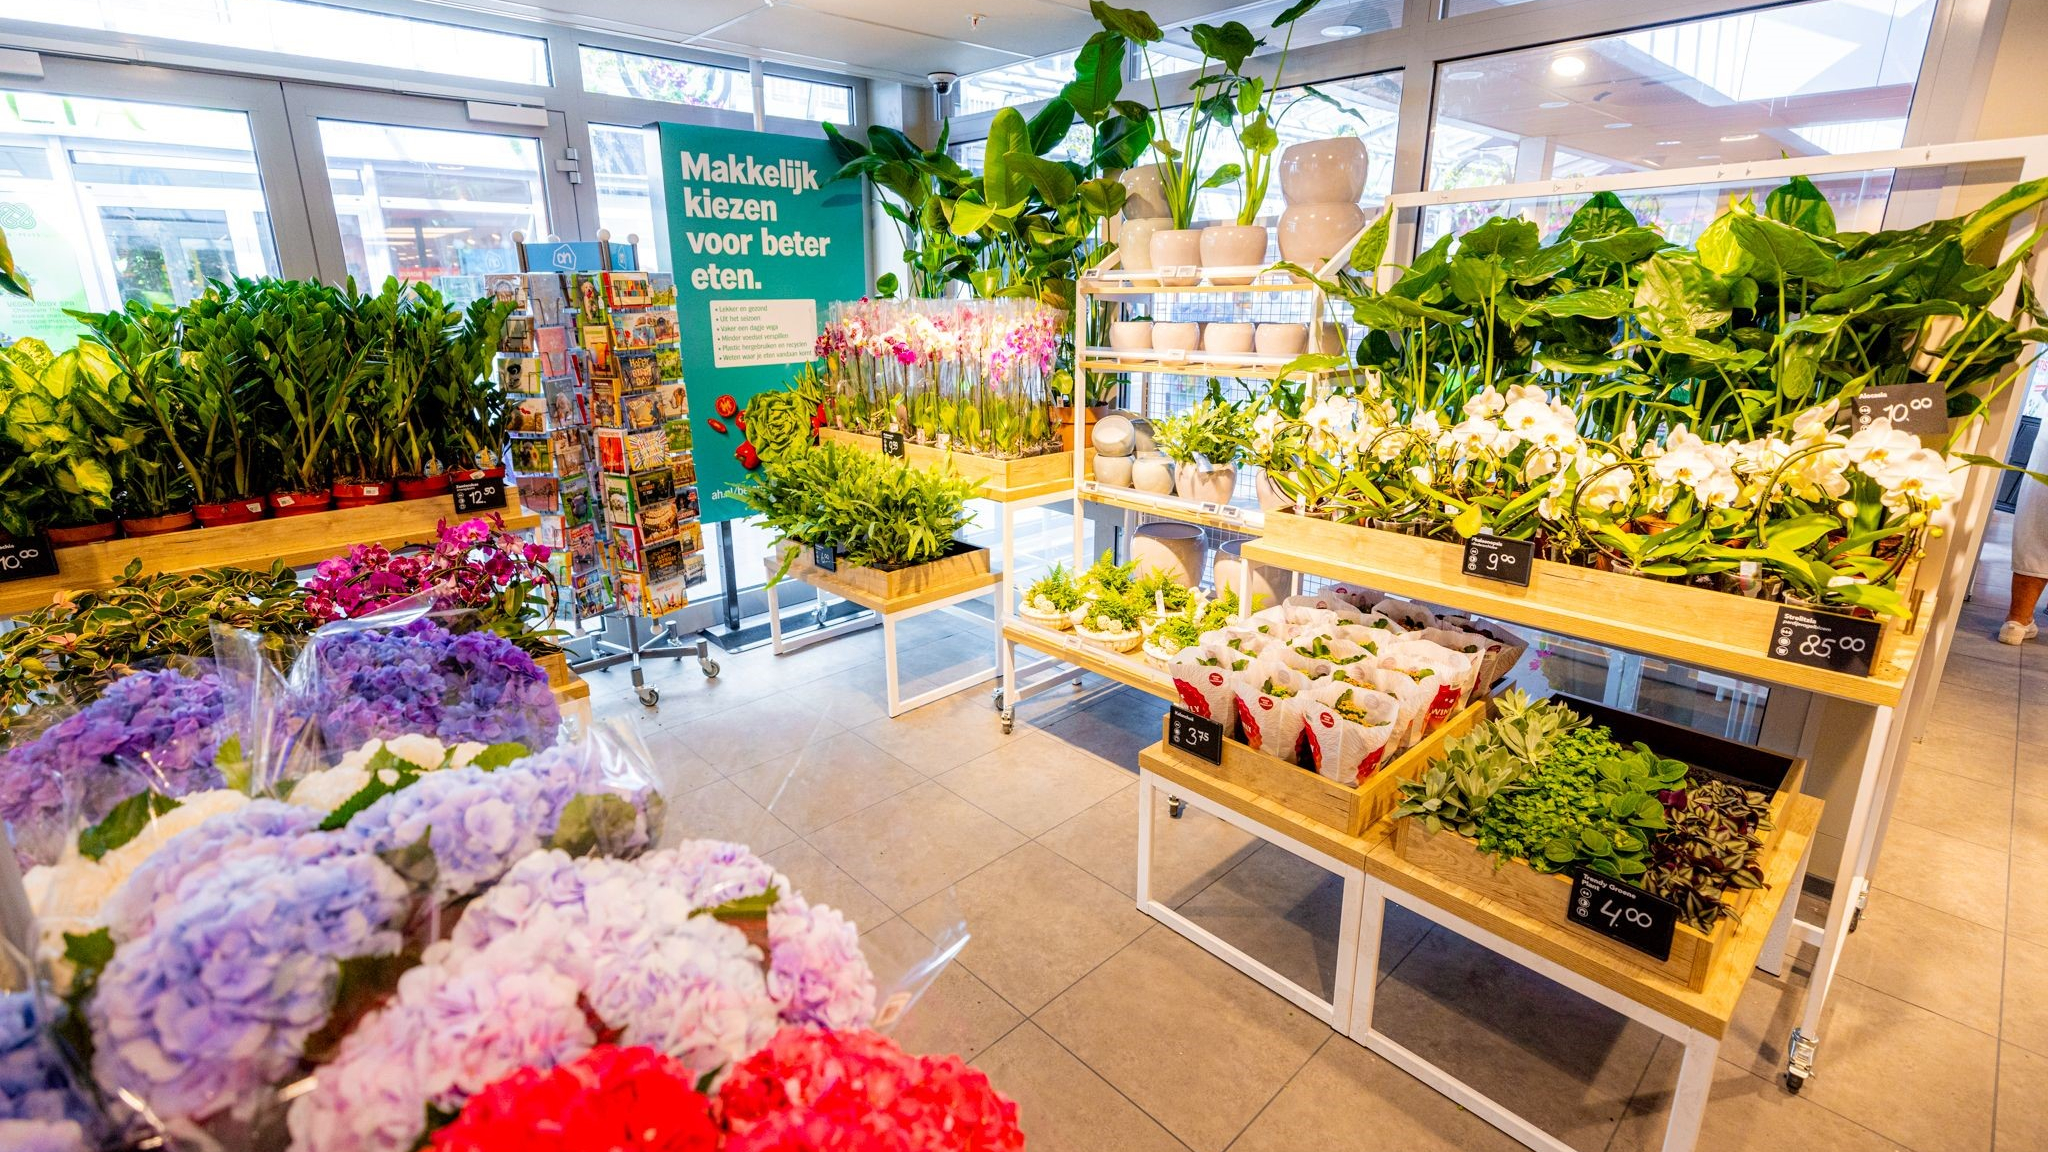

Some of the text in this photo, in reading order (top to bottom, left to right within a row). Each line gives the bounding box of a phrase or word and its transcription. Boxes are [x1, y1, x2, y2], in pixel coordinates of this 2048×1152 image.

[680, 150, 820, 195] Makkelijk
[683, 187, 778, 222] kiezen
[685, 226, 831, 257] voor beter
[691, 263, 762, 290] eten.
[748, 305, 768, 313] gezond
[749, 324, 764, 332] dagje
[764, 332, 789, 340] verspillen
[742, 343, 777, 351] hergebruiken
[786, 341, 807, 349] recyclen
[1581, 880, 1601, 891] Plant
[1583, 873, 1637, 899] Trendy Groene
